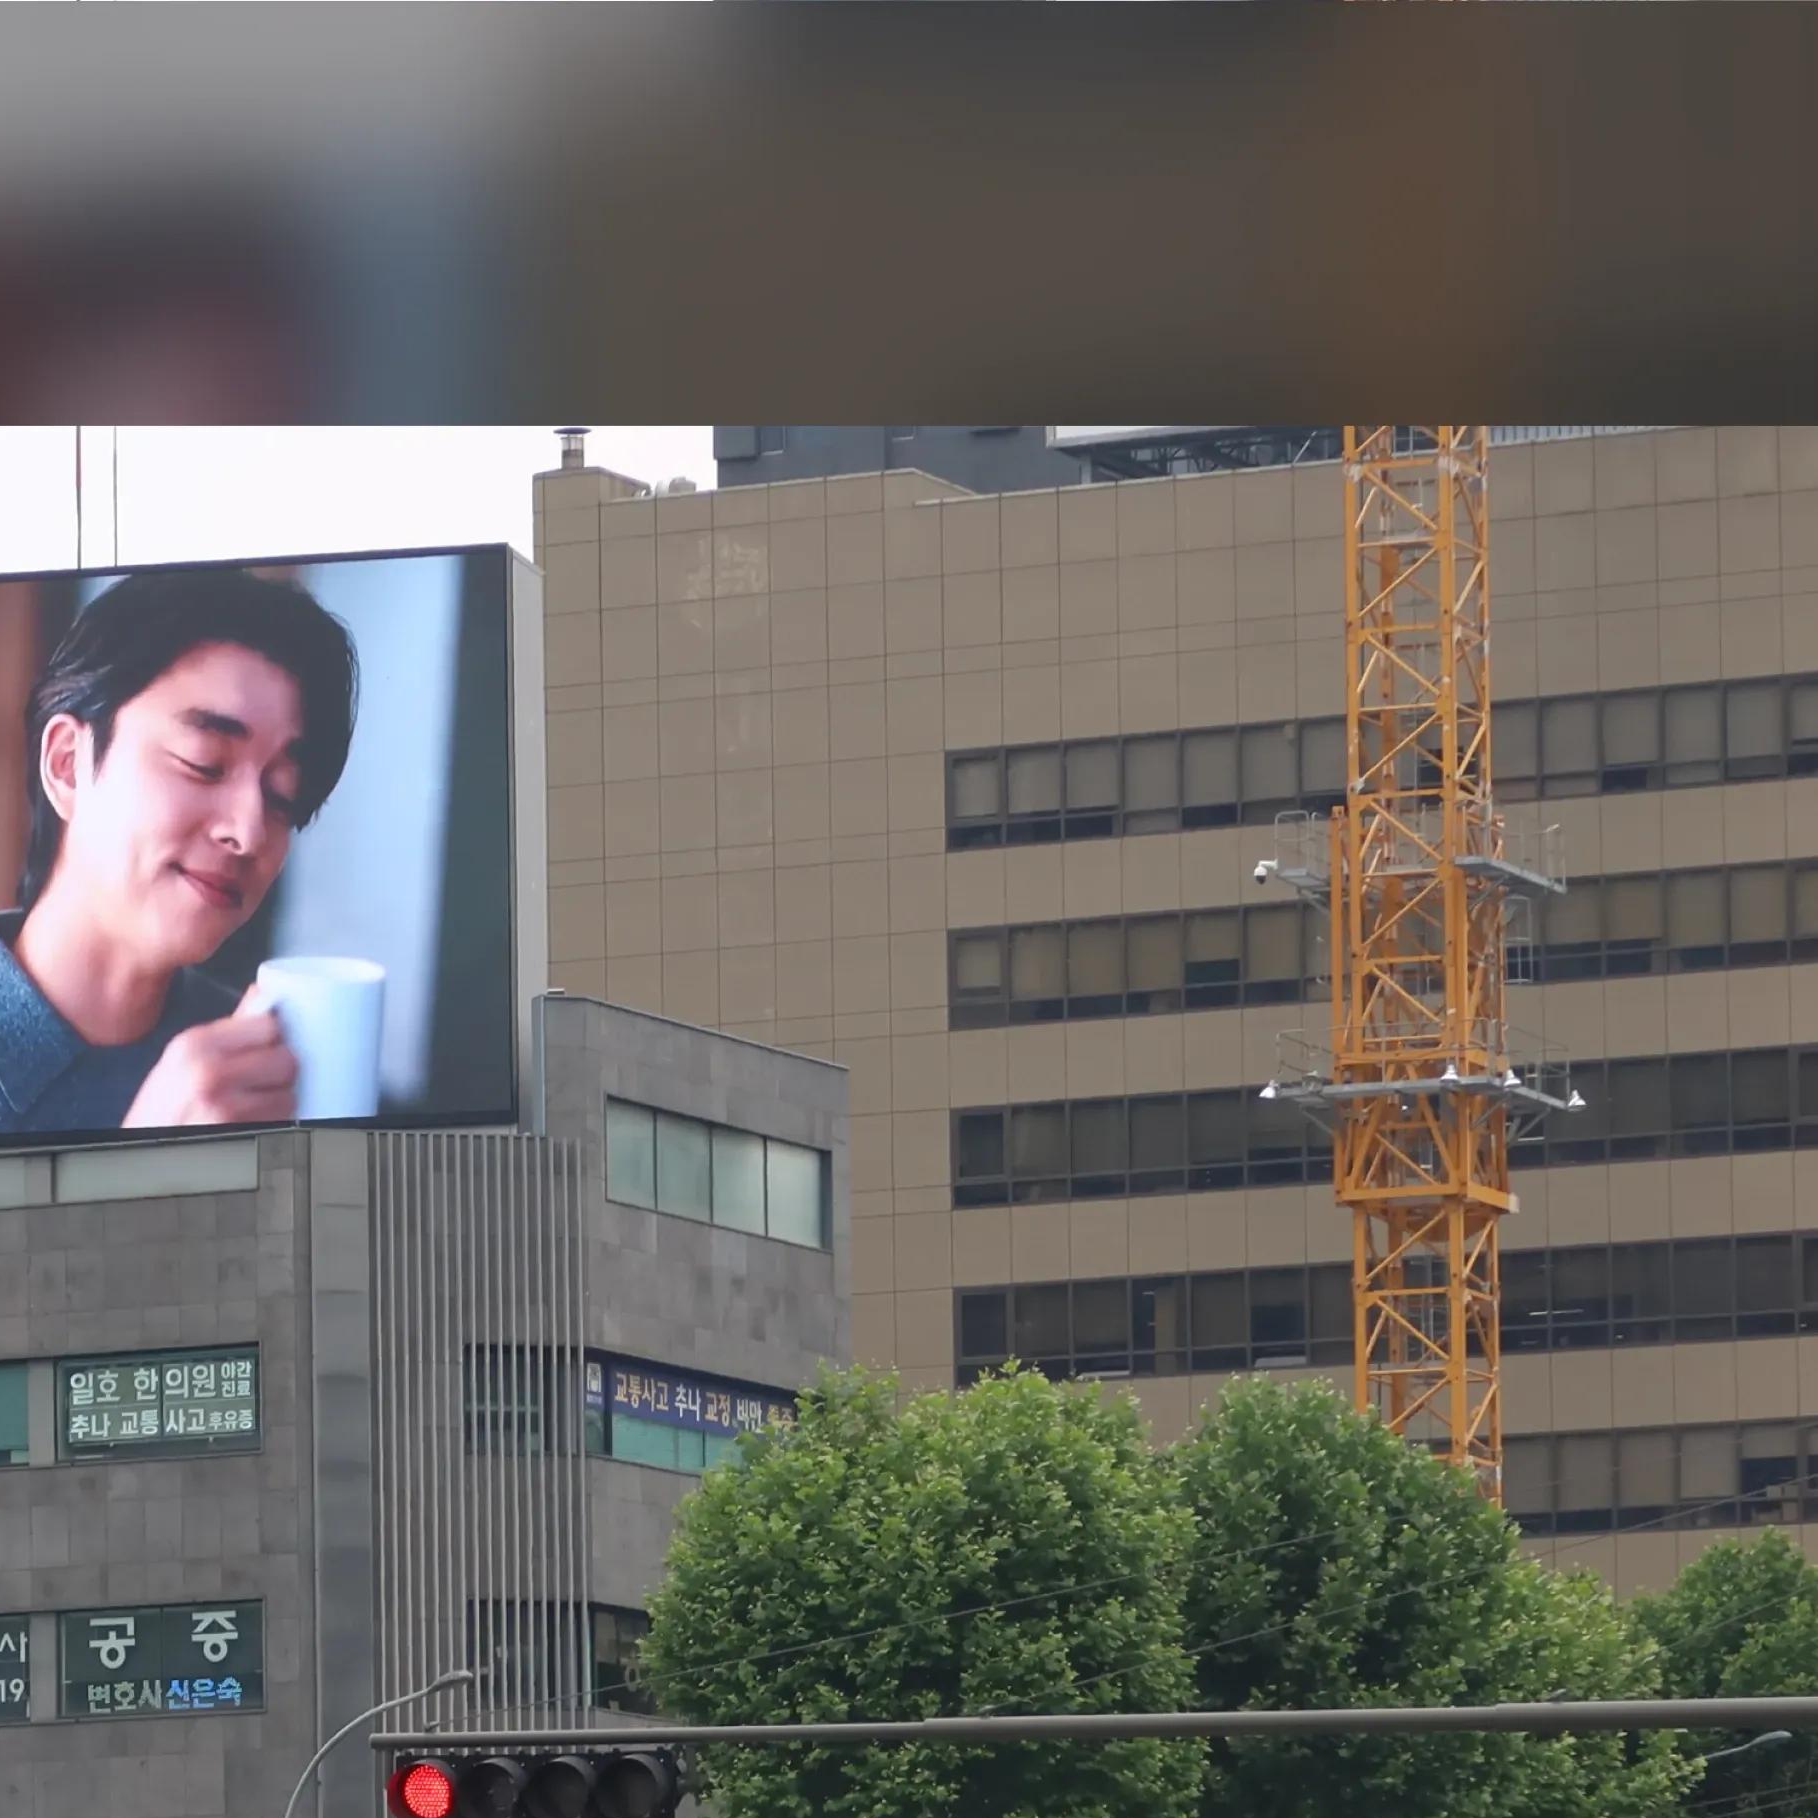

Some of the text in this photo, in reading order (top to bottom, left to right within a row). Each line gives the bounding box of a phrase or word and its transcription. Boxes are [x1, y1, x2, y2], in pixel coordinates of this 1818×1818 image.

[70, 1369, 121, 1405] 일호
[220, 1361, 252, 1379] 야간
[614, 1371, 670, 1412] 교통사고
[674, 1384, 702, 1421] 추나
[704, 1391, 731, 1427] 교정
[70, 1412, 111, 1439] 추나
[208, 1409, 253, 1431] 후유증
[87, 1677, 243, 1714] 변호사 신은숙
